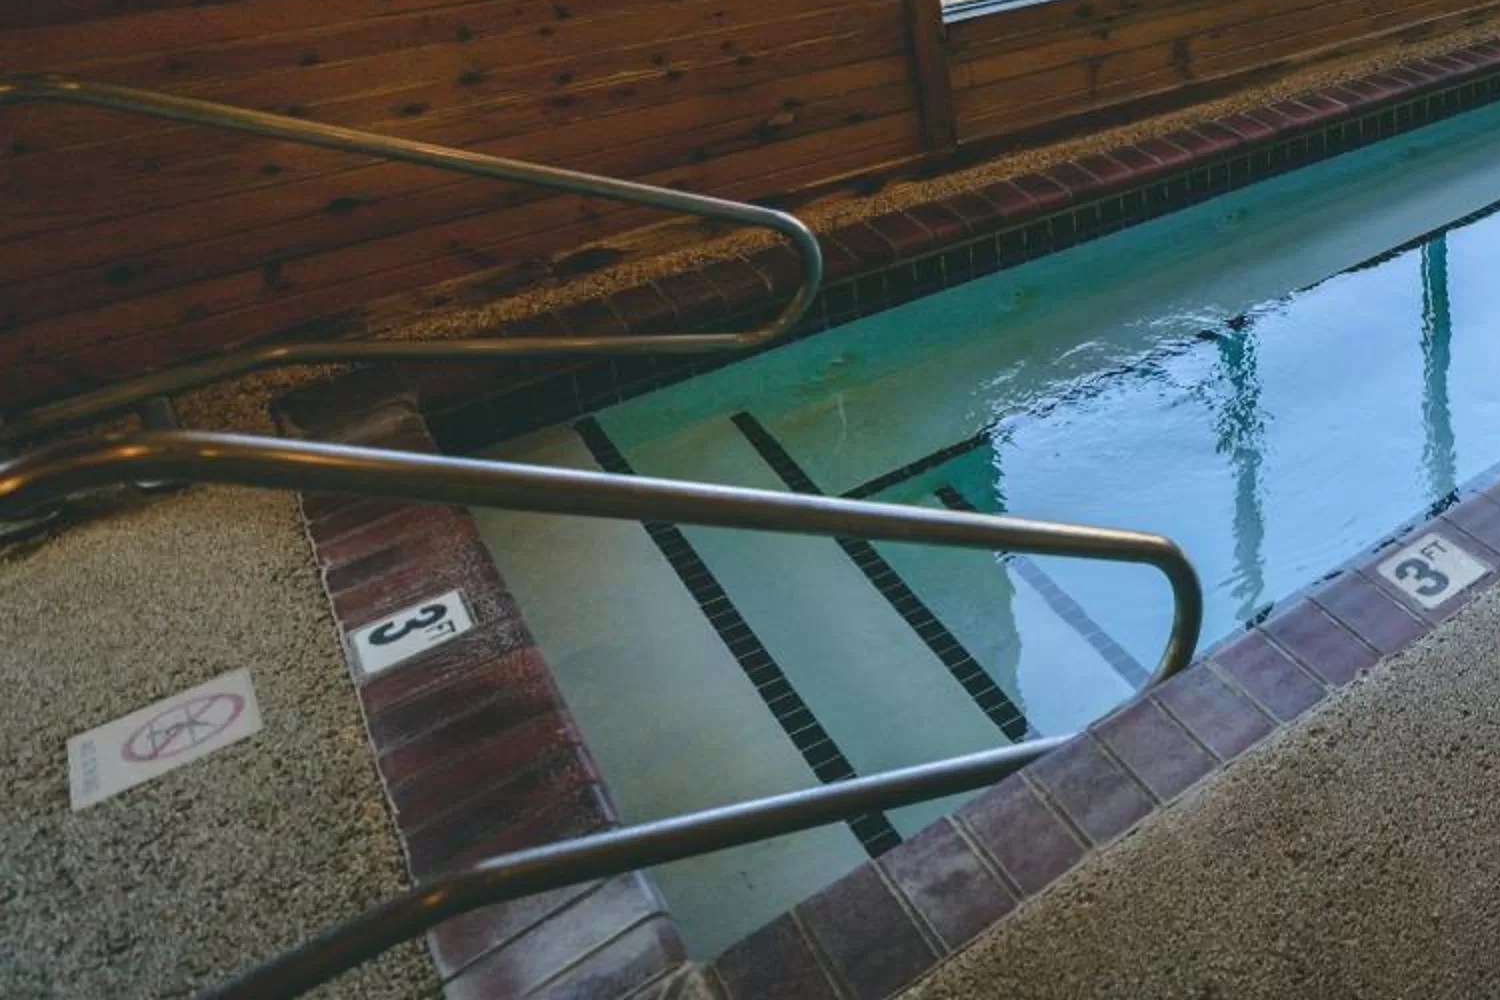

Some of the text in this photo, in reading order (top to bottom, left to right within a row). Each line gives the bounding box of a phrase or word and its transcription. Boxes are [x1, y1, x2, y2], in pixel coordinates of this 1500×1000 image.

[1395, 539, 1449, 597] 3 FT
[368, 603, 447, 645] 3
